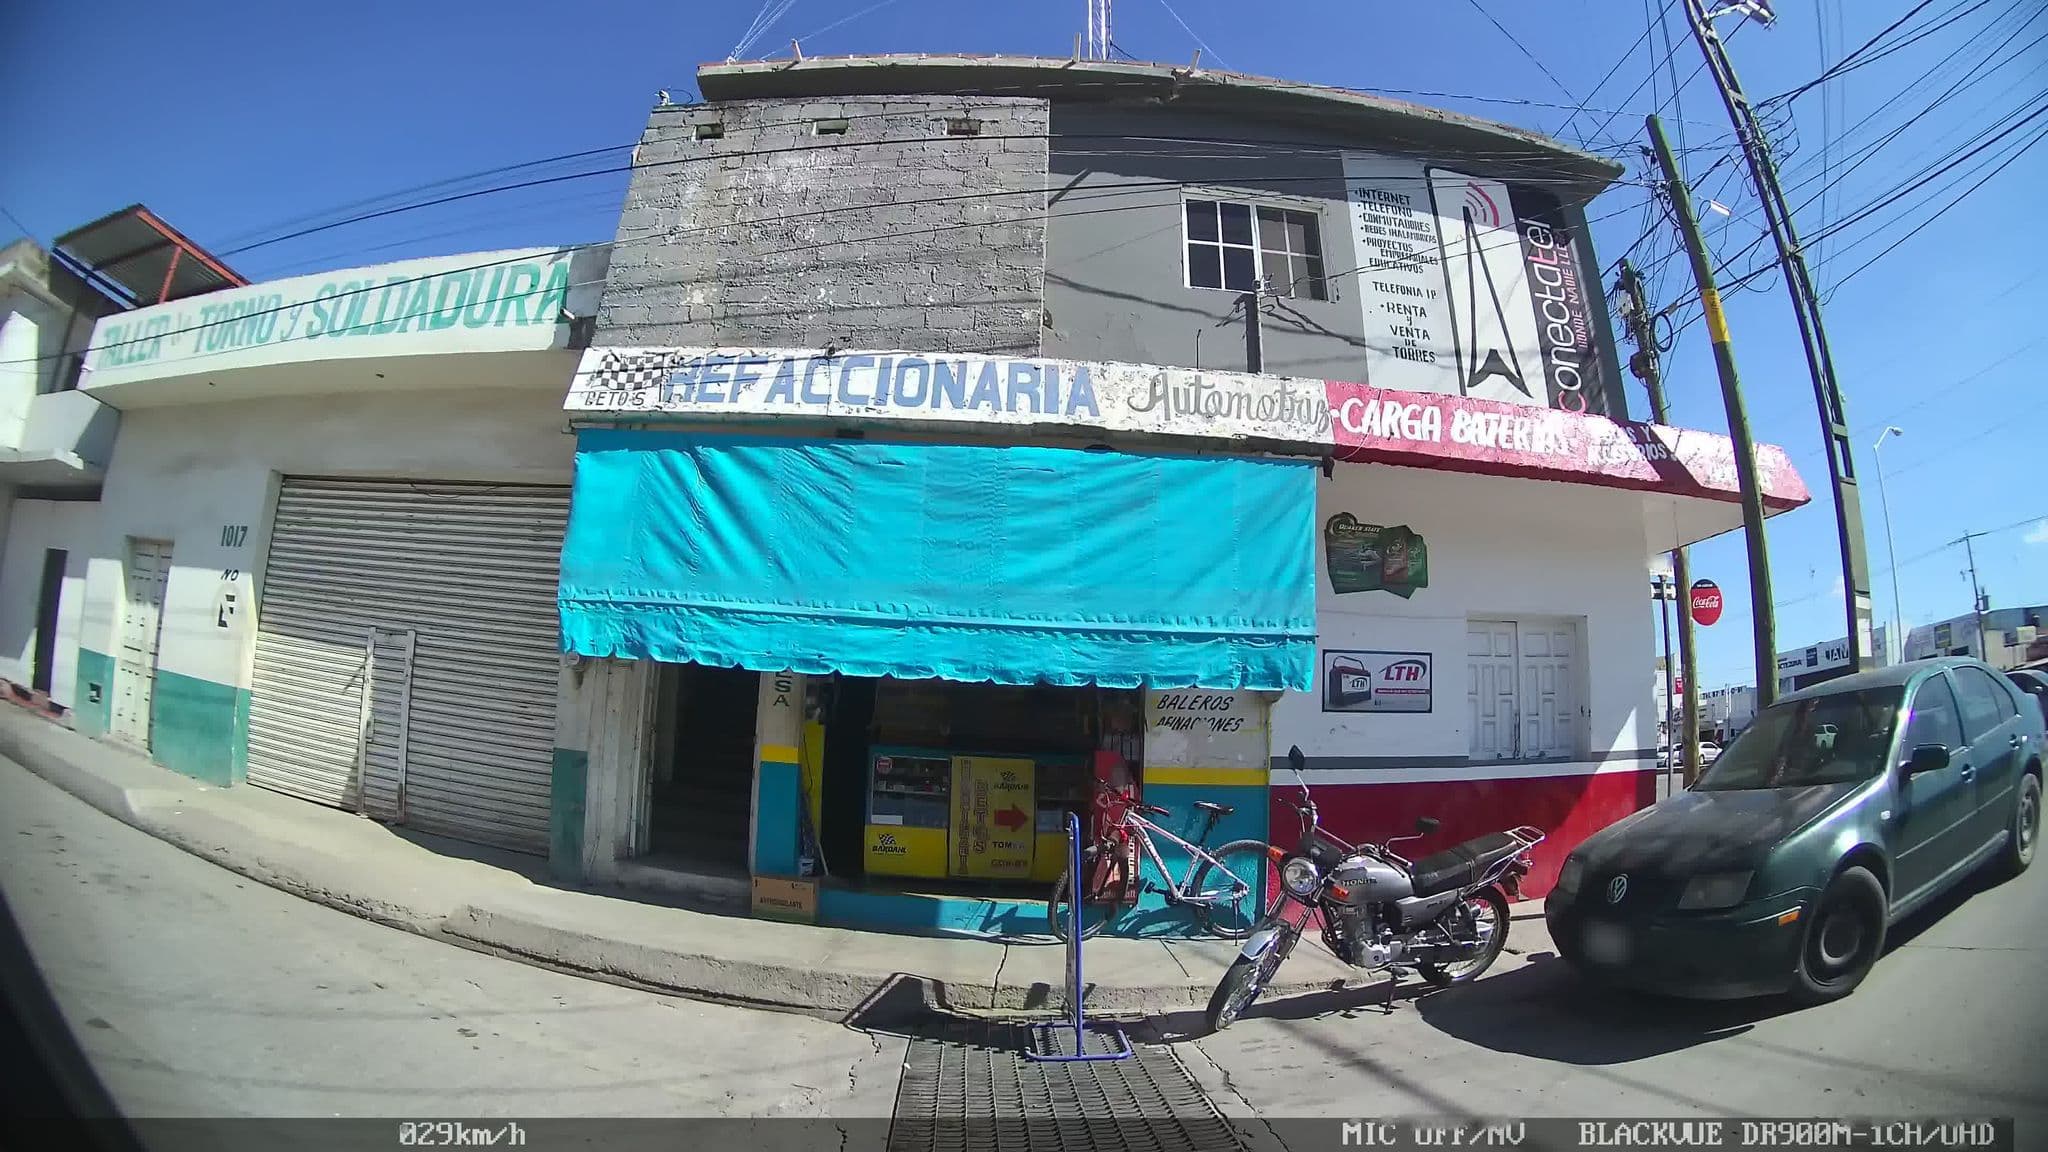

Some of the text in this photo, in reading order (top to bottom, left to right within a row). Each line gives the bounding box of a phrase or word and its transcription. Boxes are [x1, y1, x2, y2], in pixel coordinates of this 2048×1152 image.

[1360, 188, 1410, 205] INTERNET
[1361, 200, 1412, 217] TELEFONO
[1372, 281, 1436, 299] TELEFONIA IP
[1563, 269, 1579, 304] NADIE
[195, 294, 282, 353] TORNO
[306, 260, 573, 340] SOLDADURA
[1387, 302, 1427, 318] RENTA
[1390, 325, 1430, 340] VENTA
[1392, 346, 1436, 363] TORRES
[1341, 398, 1441, 442] CARGA
[221, 525, 248, 547] 1017
[221, 569, 239, 581] NO
[1384, 665, 1420, 681] LTH
[1157, 694, 1234, 710] BALEROS
